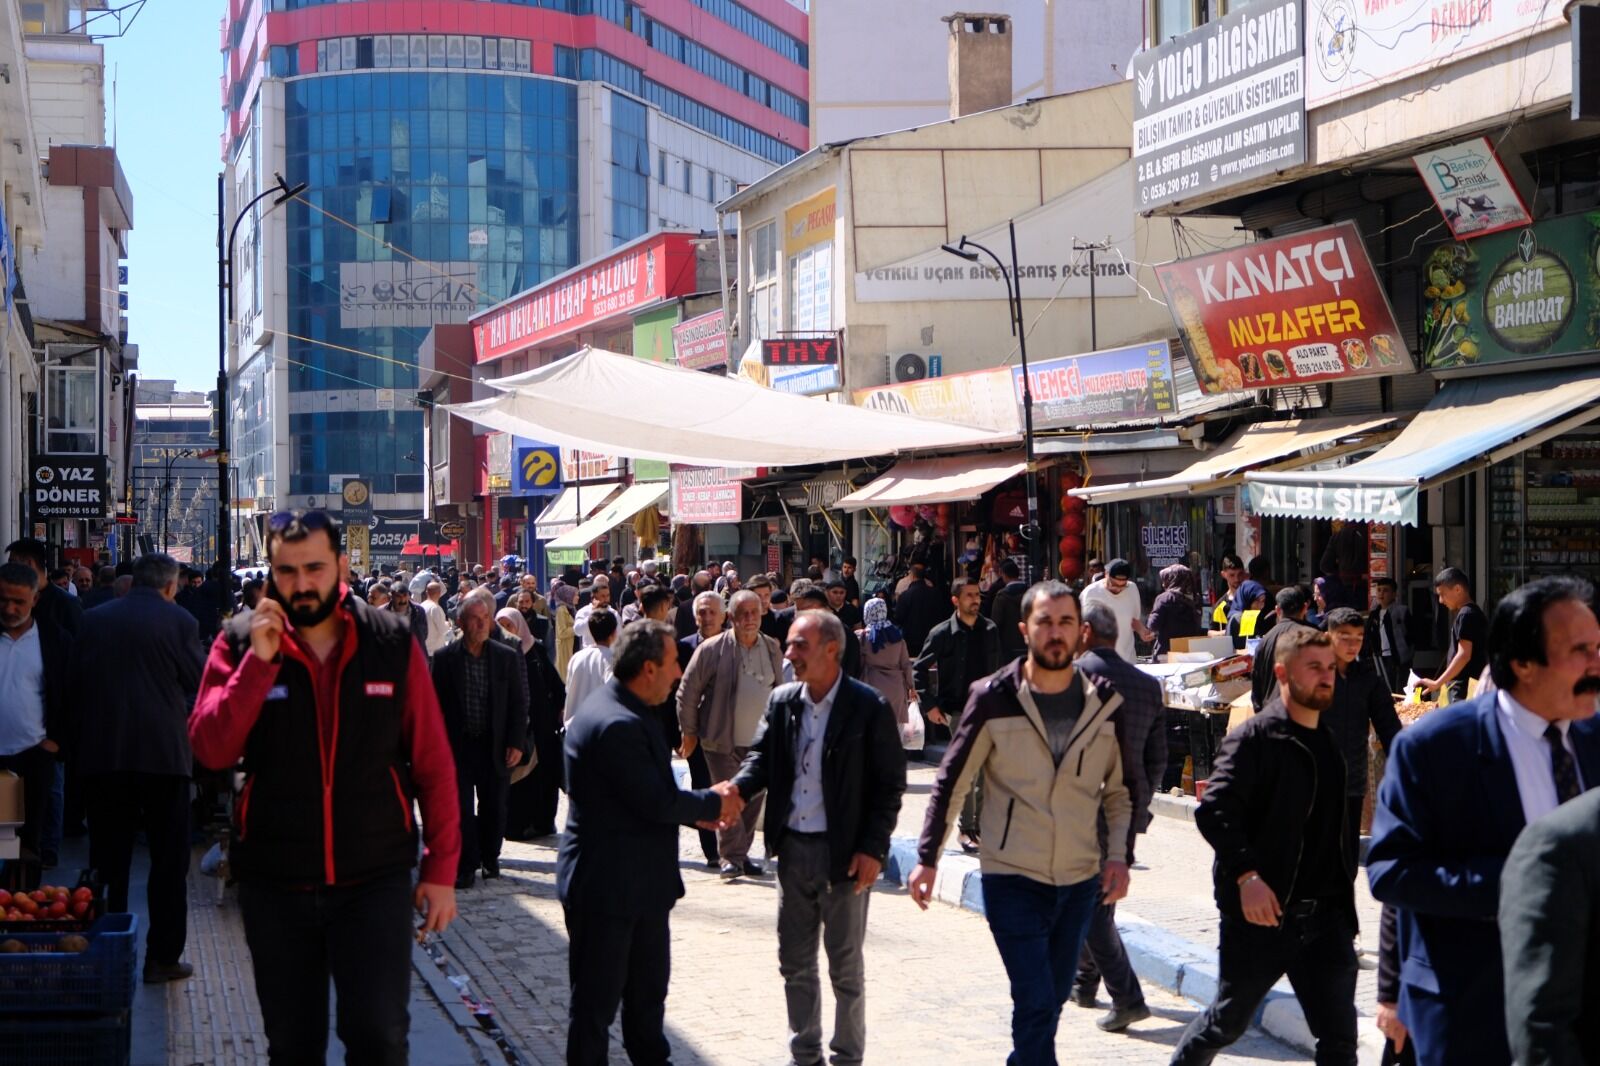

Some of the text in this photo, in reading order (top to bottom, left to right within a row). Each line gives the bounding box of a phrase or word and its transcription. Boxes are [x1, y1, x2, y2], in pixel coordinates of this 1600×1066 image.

[1158, 2, 1297, 103] YOLCU BİLGİSAYAR
[1168, 104, 1193, 138] TAMİR
[1195, 106, 1201, 128] &
[1202, 84, 1245, 124] GÜVENLİK
[1245, 63, 1300, 111] SİSTEMLERİ
[1146, 160, 1155, 179] EL
[1156, 158, 1162, 176] &
[1181, 137, 1223, 168] BİLGİSAYAR
[1224, 129, 1243, 154] ALIM
[1243, 121, 1267, 149] SATIM
[1267, 111, 1300, 139] YAPILIR
[1449, 158, 1486, 173] Berken
[1150, 171, 1200, 200] 0536 290 99 22
[1457, 171, 1489, 187] Emlak
[924, 265, 964, 283] UÇAK
[1018, 264, 1057, 282] SATIŞ
[1196, 237, 1355, 304] KANATÇI
[510, 293, 550, 338] MEVLANA
[554, 275, 587, 324] KEBAP
[591, 252, 638, 302] SALONU
[593, 292, 635, 316] 0533 680 32 65
[1228, 299, 1366, 348] MUZAFFER
[1495, 296, 1565, 329] BAHARAT
[766, 341, 832, 363] THY
[1296, 346, 1329, 359] ALO PAKET
[1127, 368, 1148, 389] USTA
[58, 467, 95, 481] YAZ
[36, 486, 101, 502] DÖNER
[1260, 482, 1401, 520] ALBİ ŞİFA
